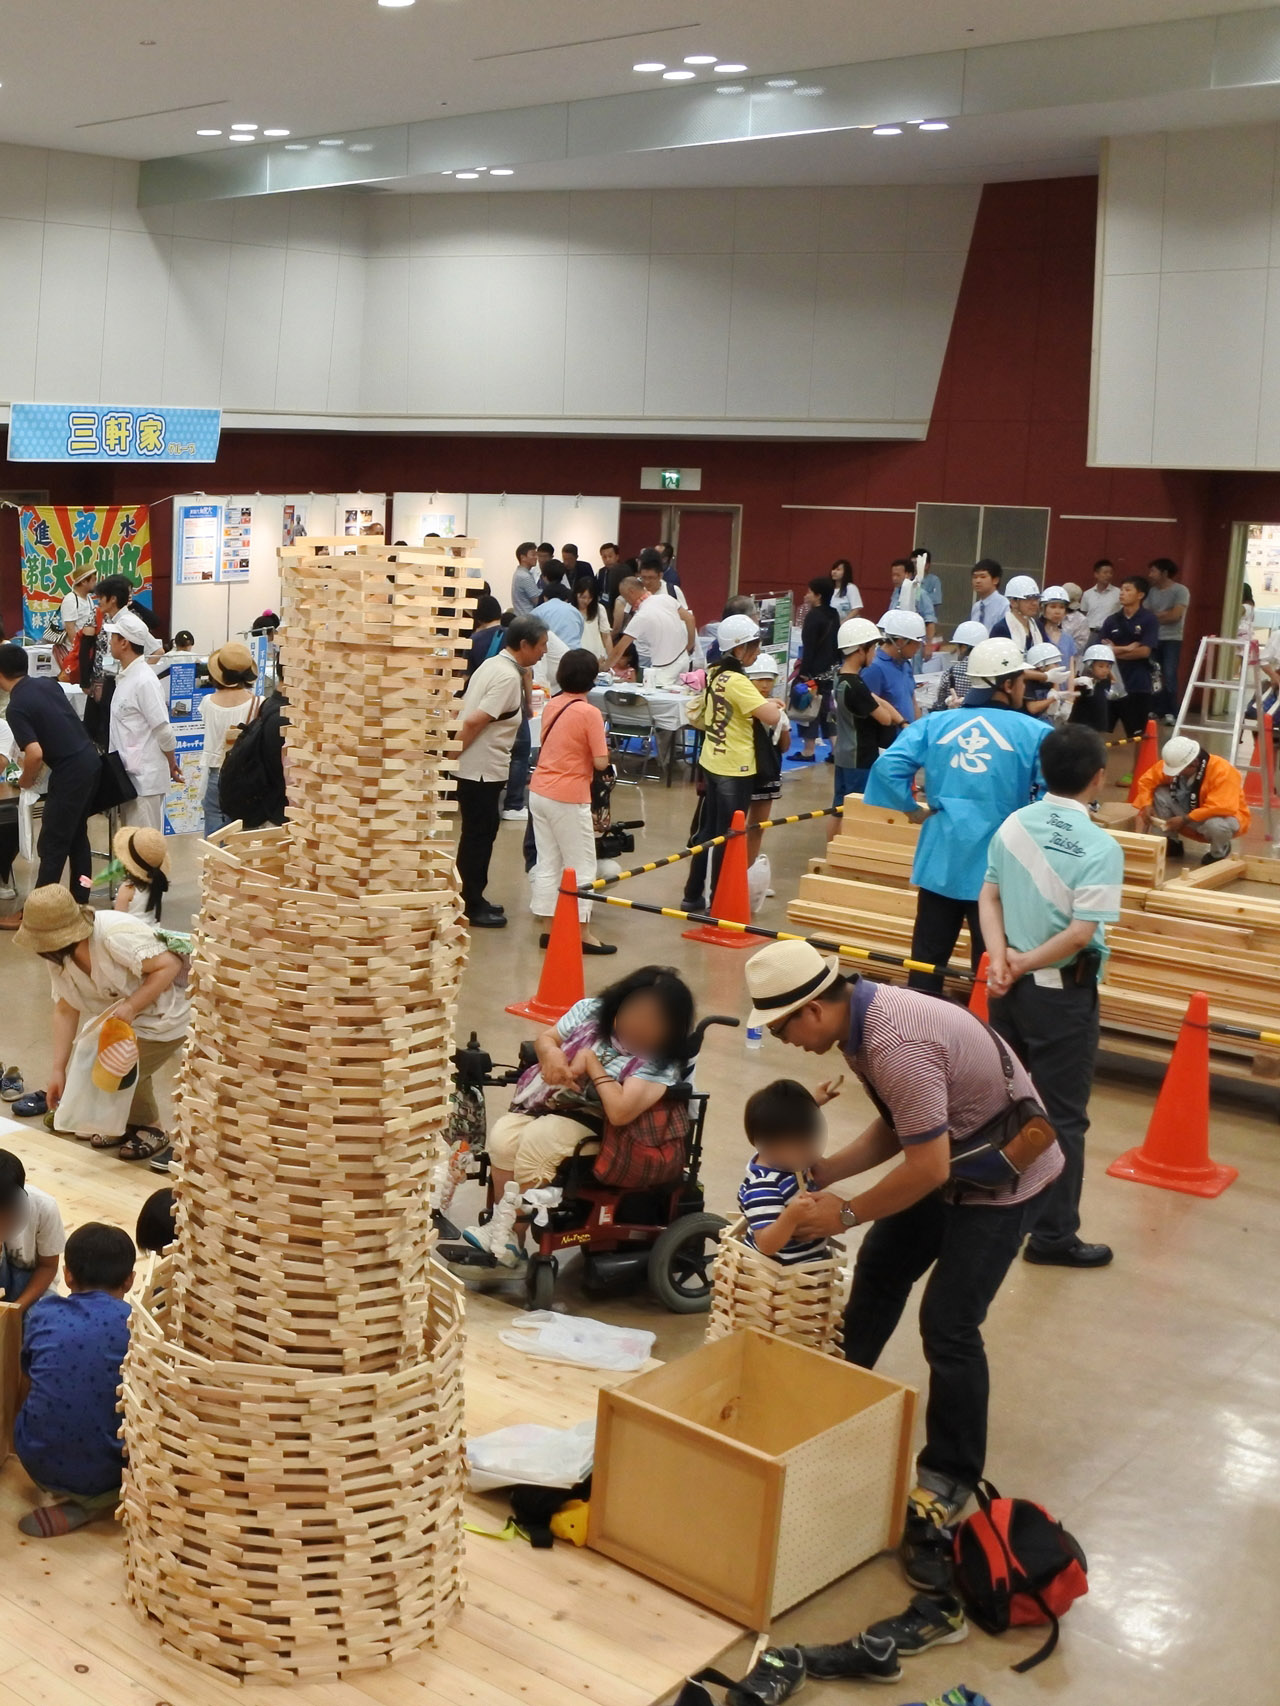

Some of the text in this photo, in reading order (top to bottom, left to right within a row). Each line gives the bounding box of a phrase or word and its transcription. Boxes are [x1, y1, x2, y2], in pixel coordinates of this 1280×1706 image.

[72, 510, 99, 542] 祝
[119, 514, 137, 539] 水
[1046, 812, 1073, 832] Team
[1048, 831, 1086, 856] Taisho
